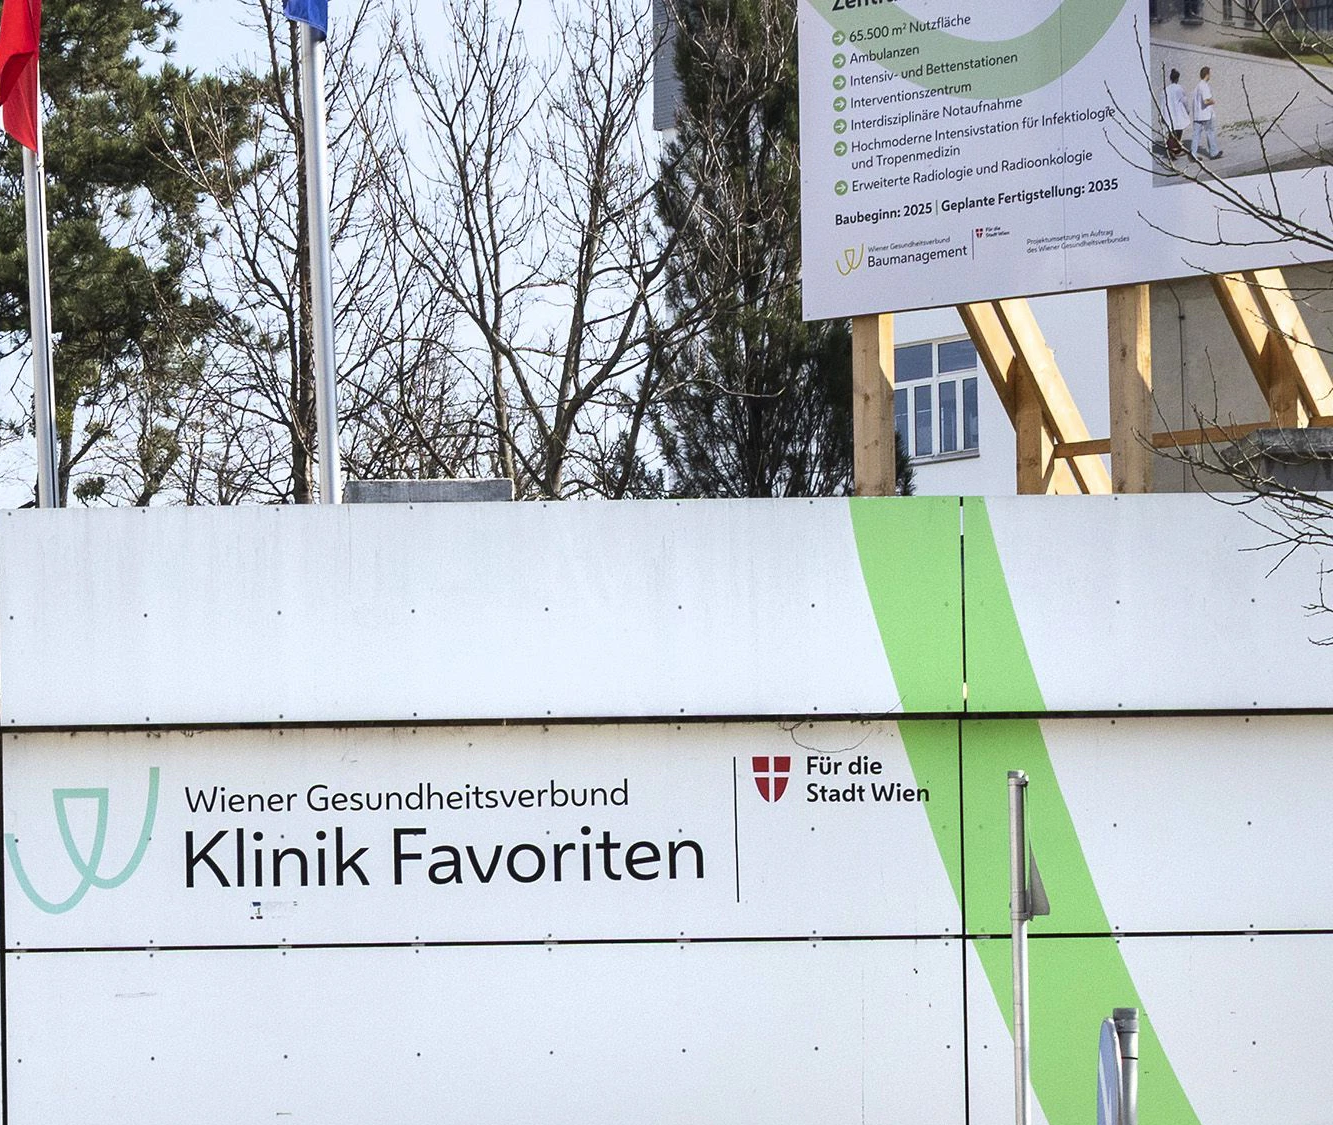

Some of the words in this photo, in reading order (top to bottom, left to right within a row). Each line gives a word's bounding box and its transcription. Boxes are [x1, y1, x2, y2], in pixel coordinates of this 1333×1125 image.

[849, 26, 889, 43] 65.500
[909, 14, 971, 34] Nutzfläche
[850, 44, 920, 65] Ambulanzen
[850, 71, 899, 88] Intensiv-
[901, 65, 923, 79] und
[926, 52, 1018, 76] Bettenstationen
[850, 82, 972, 109] Interventionszentrum
[851, 107, 940, 131] Interdisziplinäre
[942, 97, 1023, 118] Notaufnahme
[851, 132, 932, 153] Hochmoderne
[935, 120, 1019, 141] Intensivstation
[1022, 115, 1038, 130] für
[1041, 106, 1117, 127] Infektiologie
[851, 157, 874, 170] und
[877, 145, 961, 168] Tropenmedizin
[852, 175, 910, 193] Erweiterte
[913, 165, 973, 184] Radiologie
[975, 162, 998, 175] und
[1001, 150, 1093, 172] Radioonkologie
[835, 209, 901, 226] Baubeginn:
[903, 203, 933, 217] 2025
[941, 196, 995, 214] Geplante
[998, 184, 1085, 206] Fertigstellung:
[1088, 178, 1119, 193] 2035
[867, 245, 968, 268] Baumanagement
[807, 756, 842, 774] Für
[848, 756, 882, 774] die
[185, 787, 297, 812] Wiener
[307, 778, 627, 812] Gesundheitsverbund
[806, 783, 866, 803] Stadt
[872, 783, 930, 802] Wien
[186, 827, 369, 887] Klinik
[393, 826, 704, 885] Favoriten
